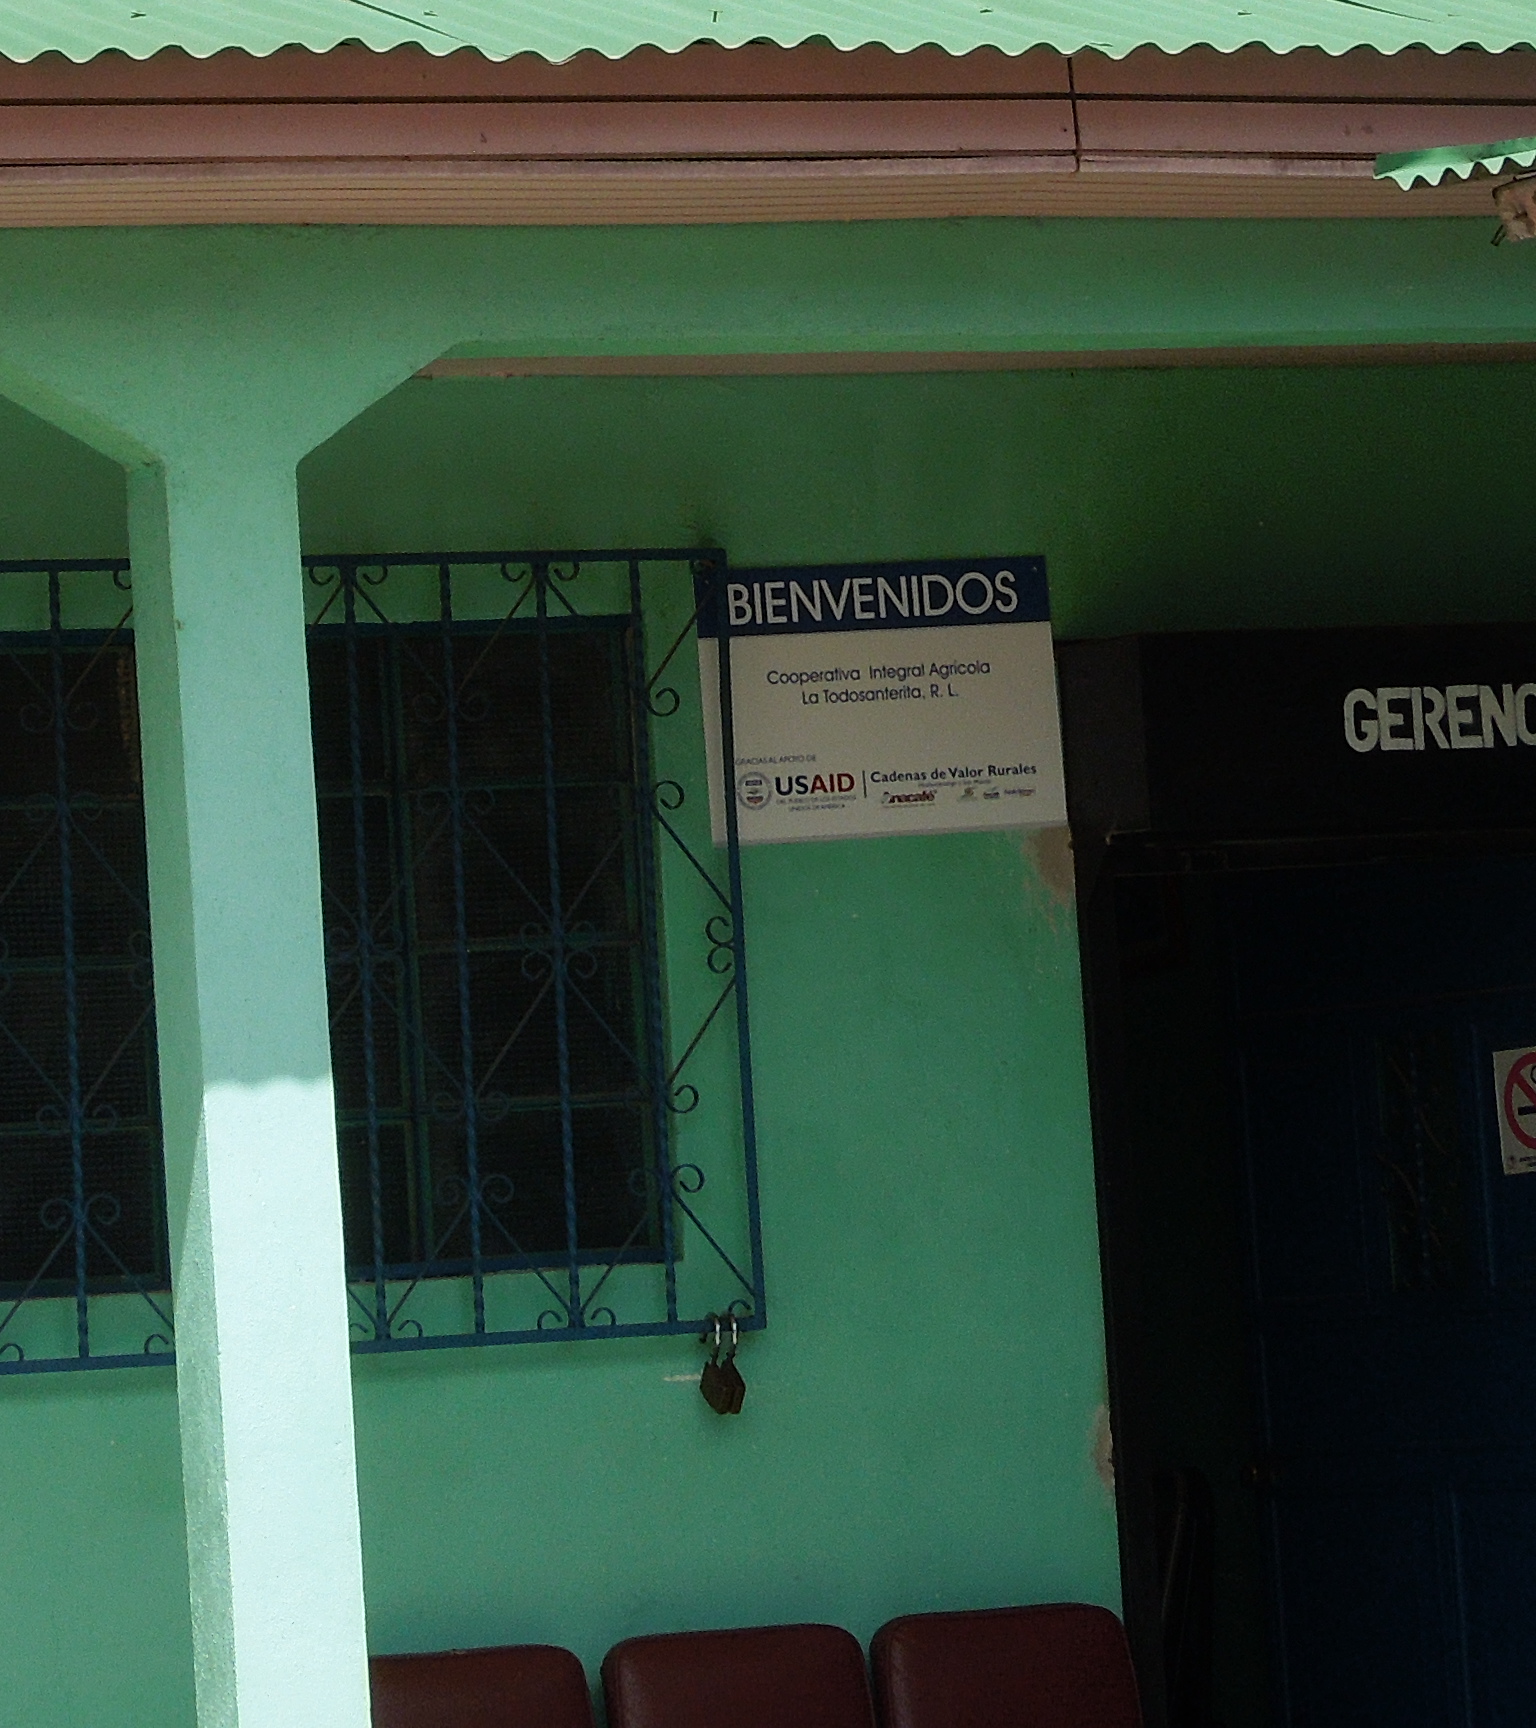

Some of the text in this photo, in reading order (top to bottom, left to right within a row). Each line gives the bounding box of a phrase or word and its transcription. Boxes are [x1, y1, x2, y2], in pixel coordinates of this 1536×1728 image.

[726, 569, 1019, 627] BIENVENIDOS
[766, 667, 861, 686] Cooperativa
[868, 663, 925, 681] Integral
[801, 689, 819, 706] La
[774, 772, 856, 797] USAID
[869, 769, 927, 784] Cadenas
[930, 767, 946, 781] de
[947, 765, 984, 779] Valor
[987, 763, 1038, 777] Rurales
